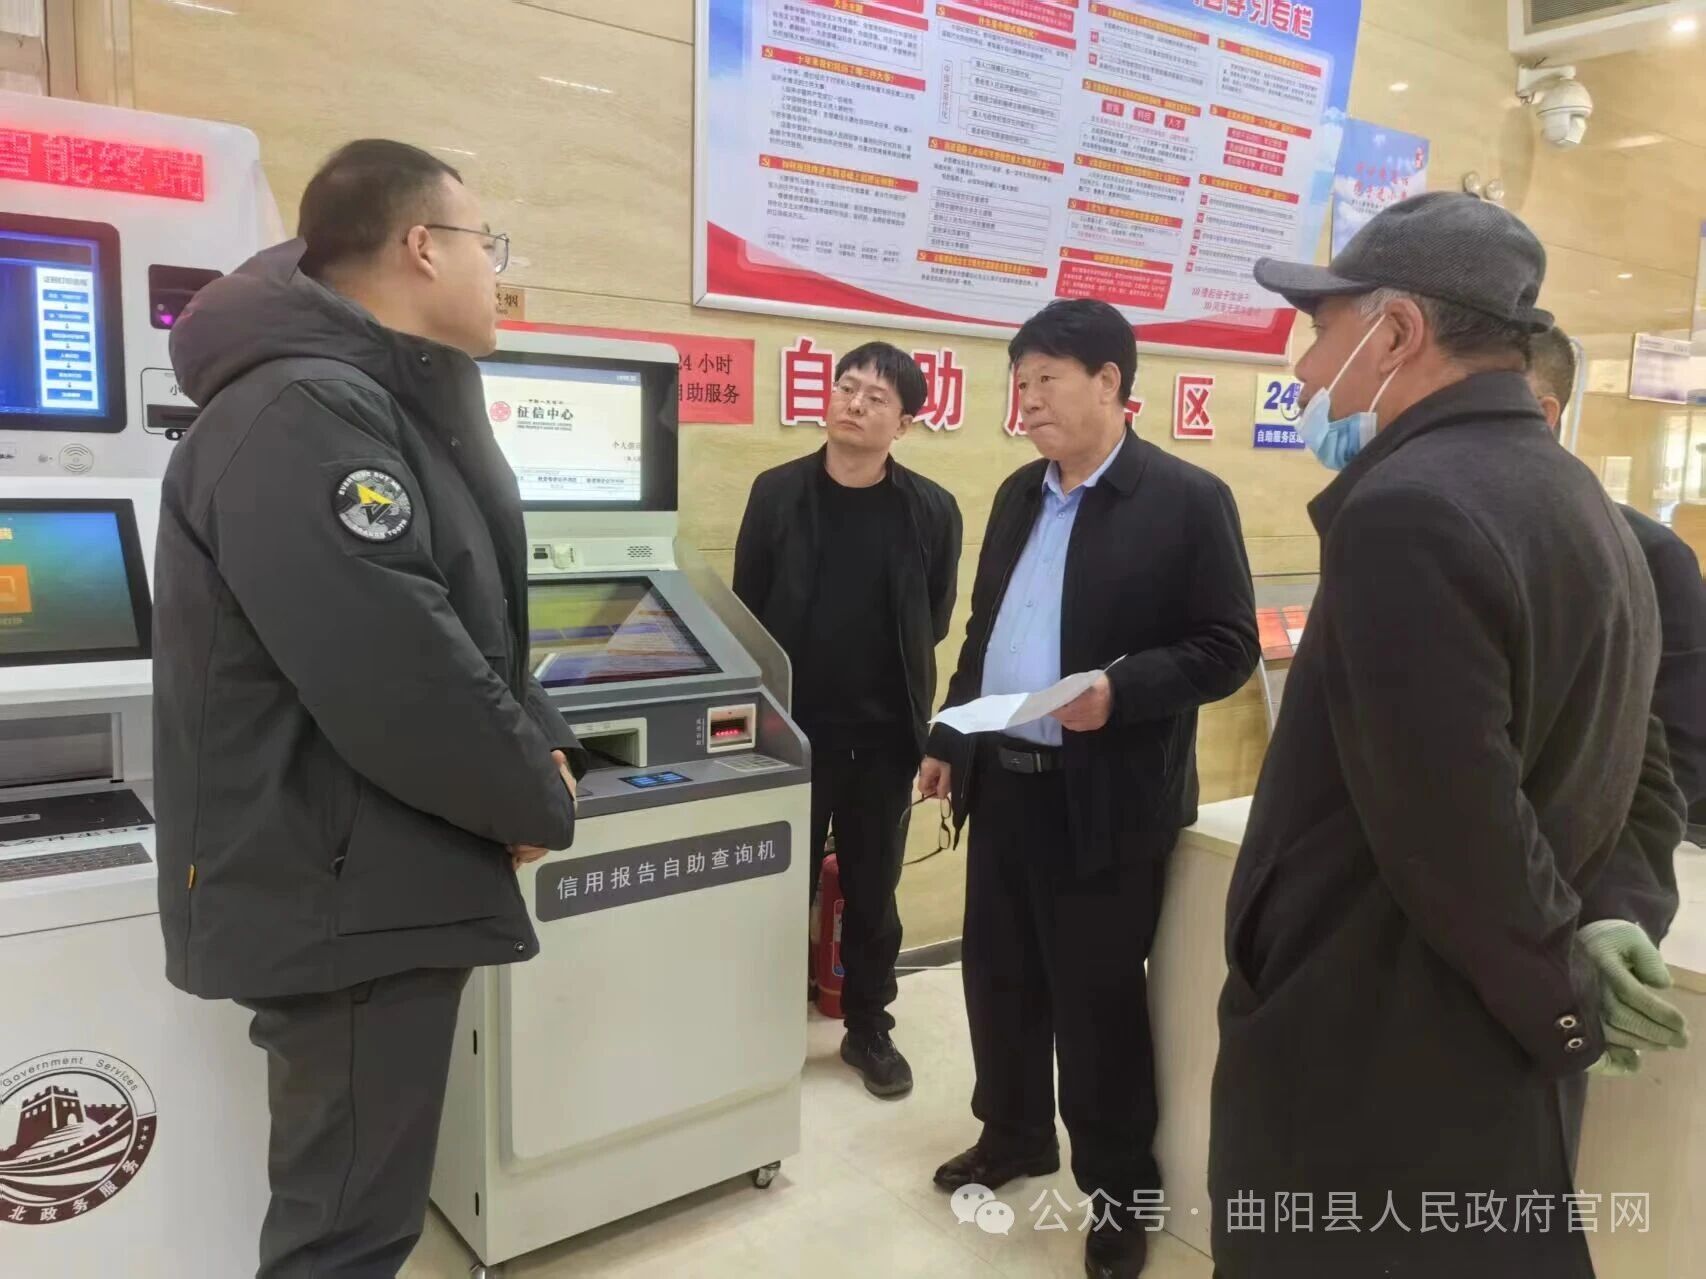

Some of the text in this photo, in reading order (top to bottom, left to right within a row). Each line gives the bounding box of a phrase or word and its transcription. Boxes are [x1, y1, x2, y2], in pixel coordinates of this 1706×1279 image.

[698, 353, 733, 374] 小时
[517, 405, 574, 421] 征信中心
[557, 841, 776, 901] 信用报告自助查询机
[2, 1056, 138, 1092] Government Services
